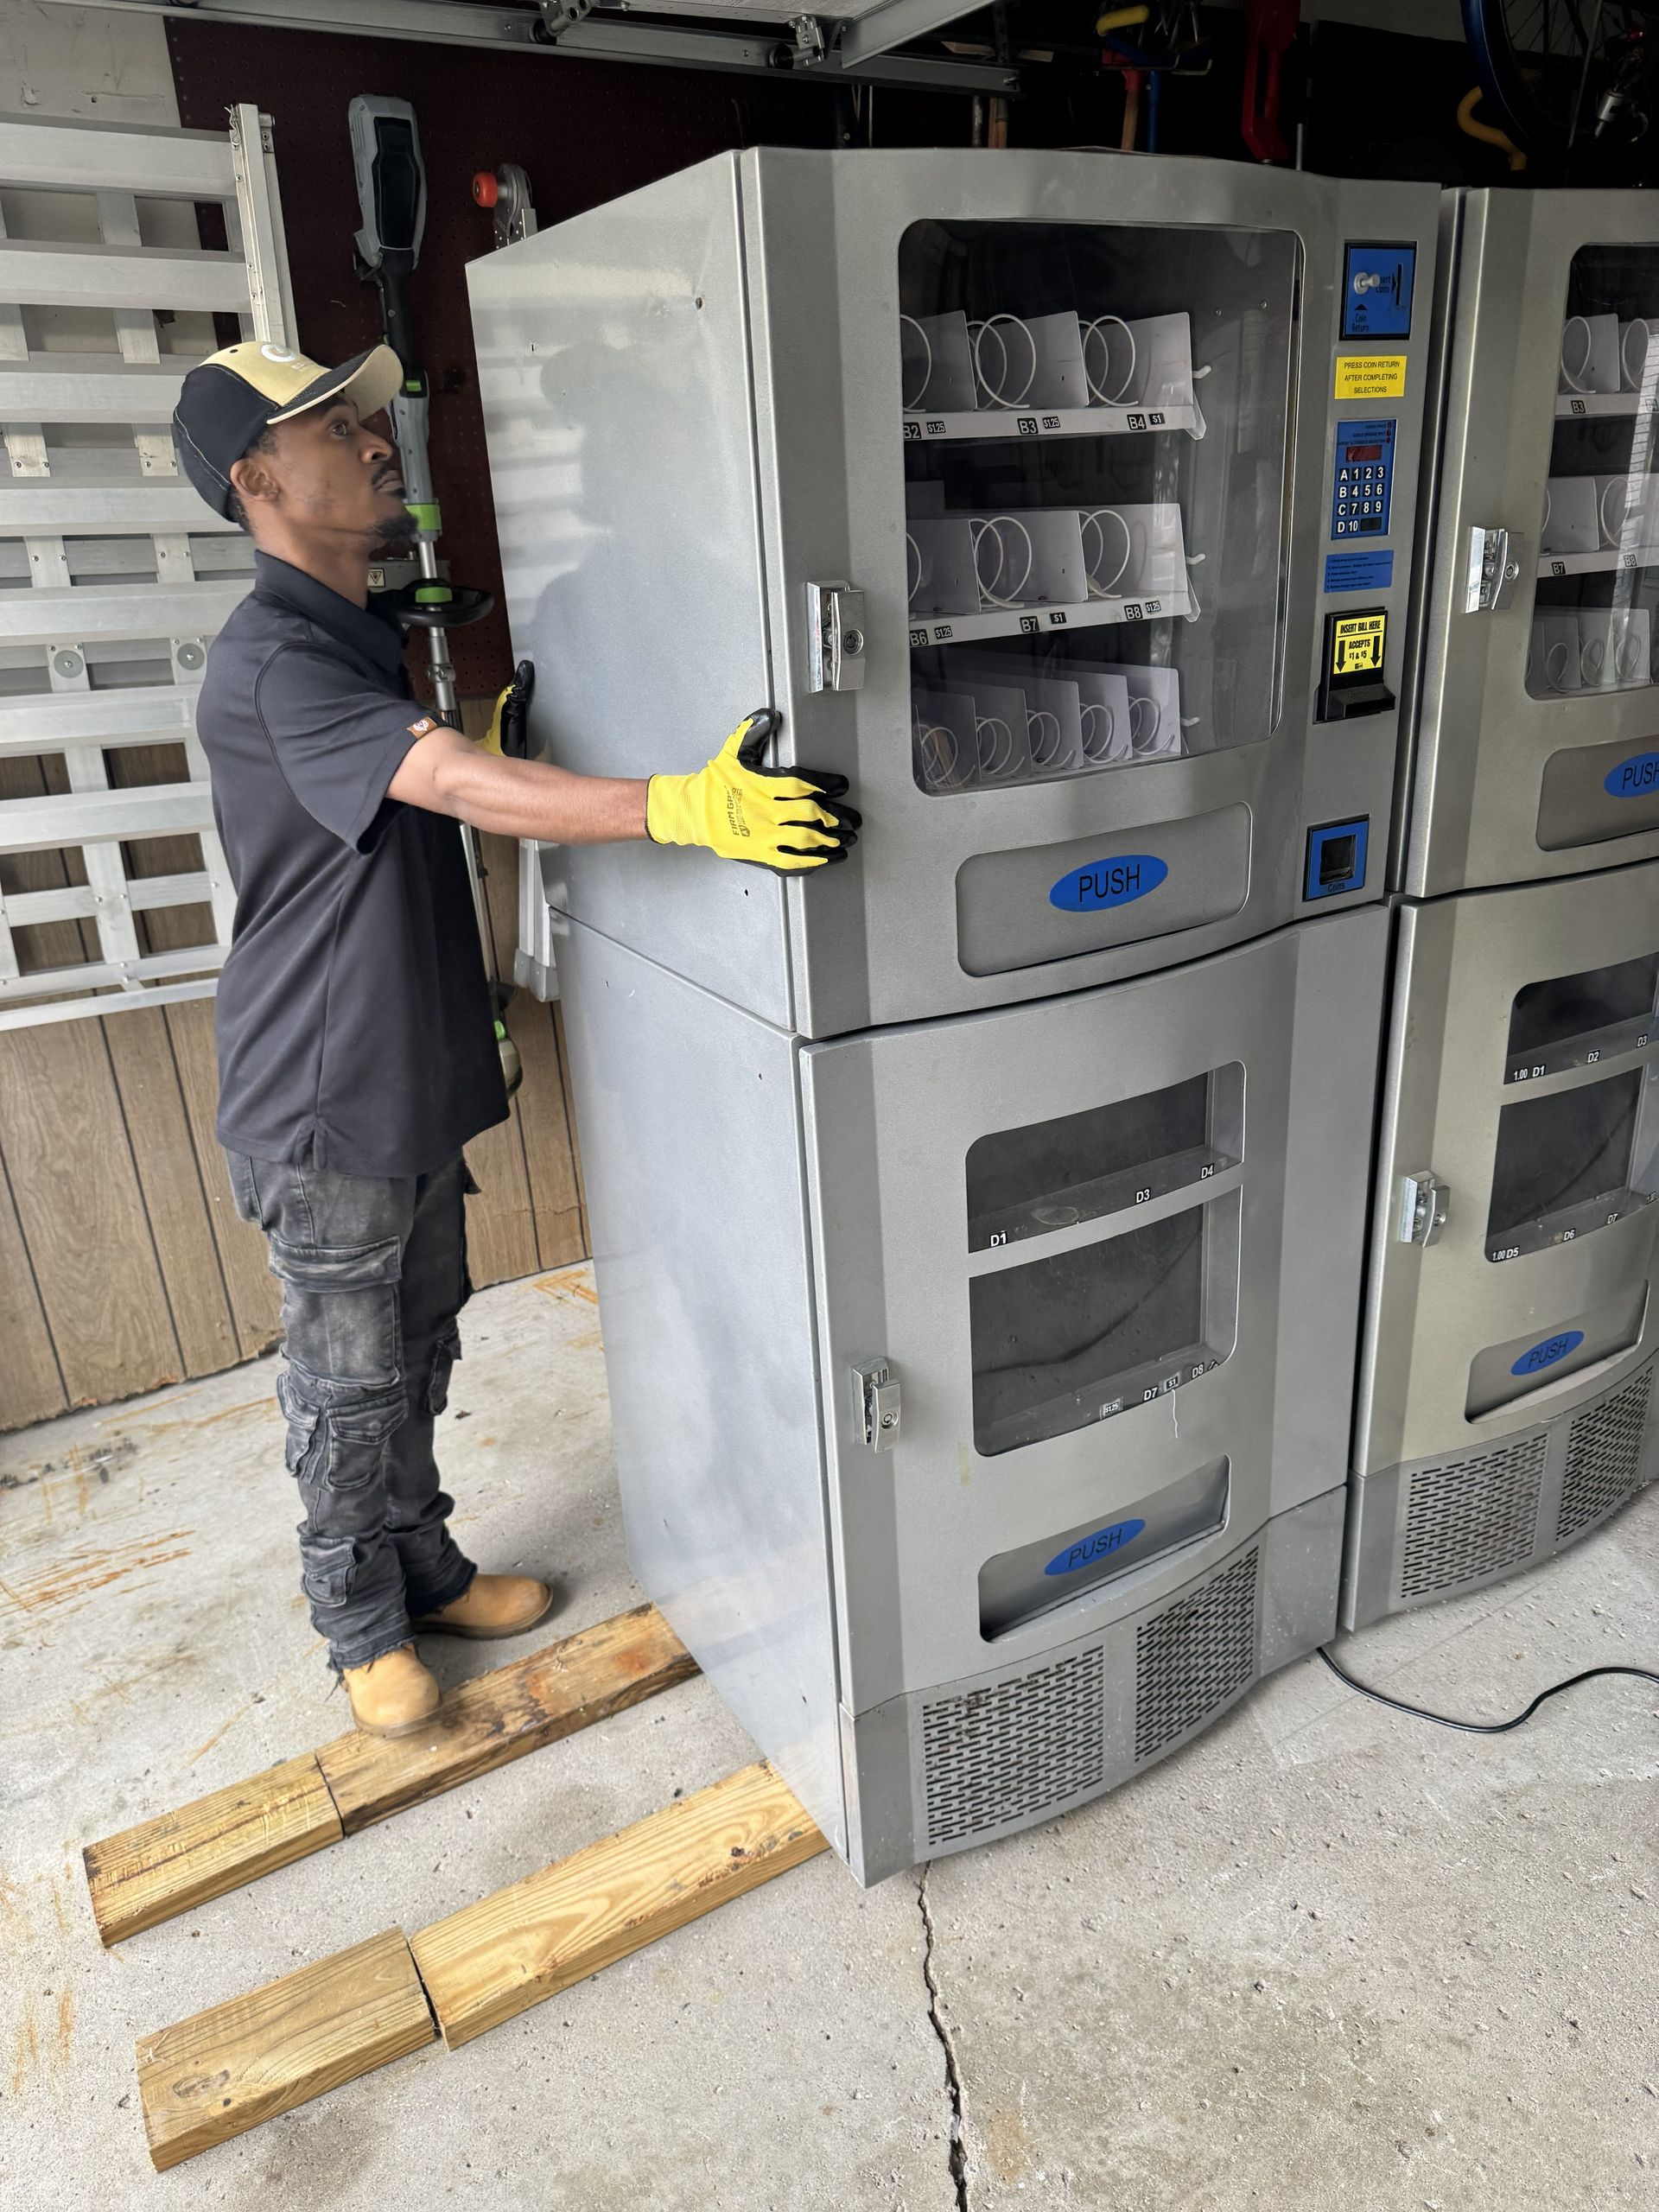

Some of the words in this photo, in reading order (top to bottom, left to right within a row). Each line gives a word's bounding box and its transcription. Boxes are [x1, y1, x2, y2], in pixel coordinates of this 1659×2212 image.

[1355, 313, 1367, 322] Coin
[1351, 323, 1369, 333] Return
[1363, 372, 1398, 381] COMPLETING
[1353, 385, 1388, 394] SELECTIONS
[1573, 401, 1584, 412] B3
[1019, 420, 1037, 434] B3
[1128, 416, 1145, 429] B4
[1152, 414, 1162, 423] $1
[1339, 469, 1348, 481] A
[1353, 467, 1359, 480] 1
[1365, 467, 1372, 480] 2
[1377, 467, 1384, 479] 3
[1338, 486, 1347, 499] B
[1351, 486, 1358, 498] 4
[1364, 484, 1371, 496] 5
[1376, 483, 1382, 495] 6
[1338, 504, 1346, 516] C
[1351, 503, 1358, 515] 7
[1363, 501, 1370, 513] 8
[1375, 500, 1382, 512] 9
[1337, 521, 1345, 533] D
[1348, 520, 1358, 532] 10
[1624, 555, 1637, 566] B8
[1553, 563, 1564, 575] B7
[1126, 606, 1141, 620] B8
[1021, 618, 1037, 632] B7
[1053, 613, 1064, 623] $1
[1340, 623, 1357, 634] INSERT
[1357, 621, 1368, 632] BILL
[1369, 620, 1382, 630] HERE
[910, 632, 928, 646] B6
[1348, 639, 1370, 650] ACCEPTS
[1349, 652, 1355, 660] $1
[1360, 650, 1367, 659] $5
[727, 811, 740, 836] FIRM
[1079, 864, 1141, 902] PUSH
[1327, 882, 1345, 893] Coins
[1637, 1035, 1648, 1047] D3
[1587, 1052, 1599, 1064] D2
[1514, 1068, 1528, 1081] 1.00
[1532, 1065, 1545, 1077] D1
[1200, 1164, 1214, 1179] D4
[1135, 1188, 1150, 1204] D3
[1607, 1213, 1618, 1224] D7
[990, 1232, 1007, 1247] D1
[1563, 1230, 1575, 1241] D6
[1492, 1249, 1506, 1262] 1.00
[1506, 1247, 1519, 1259] D5
[1528, 1338, 1569, 1370] PUSH
[1192, 1363, 1204, 1379] D8
[1143, 1387, 1158, 1401] D7
[1068, 1528, 1122, 1567] PUSH
